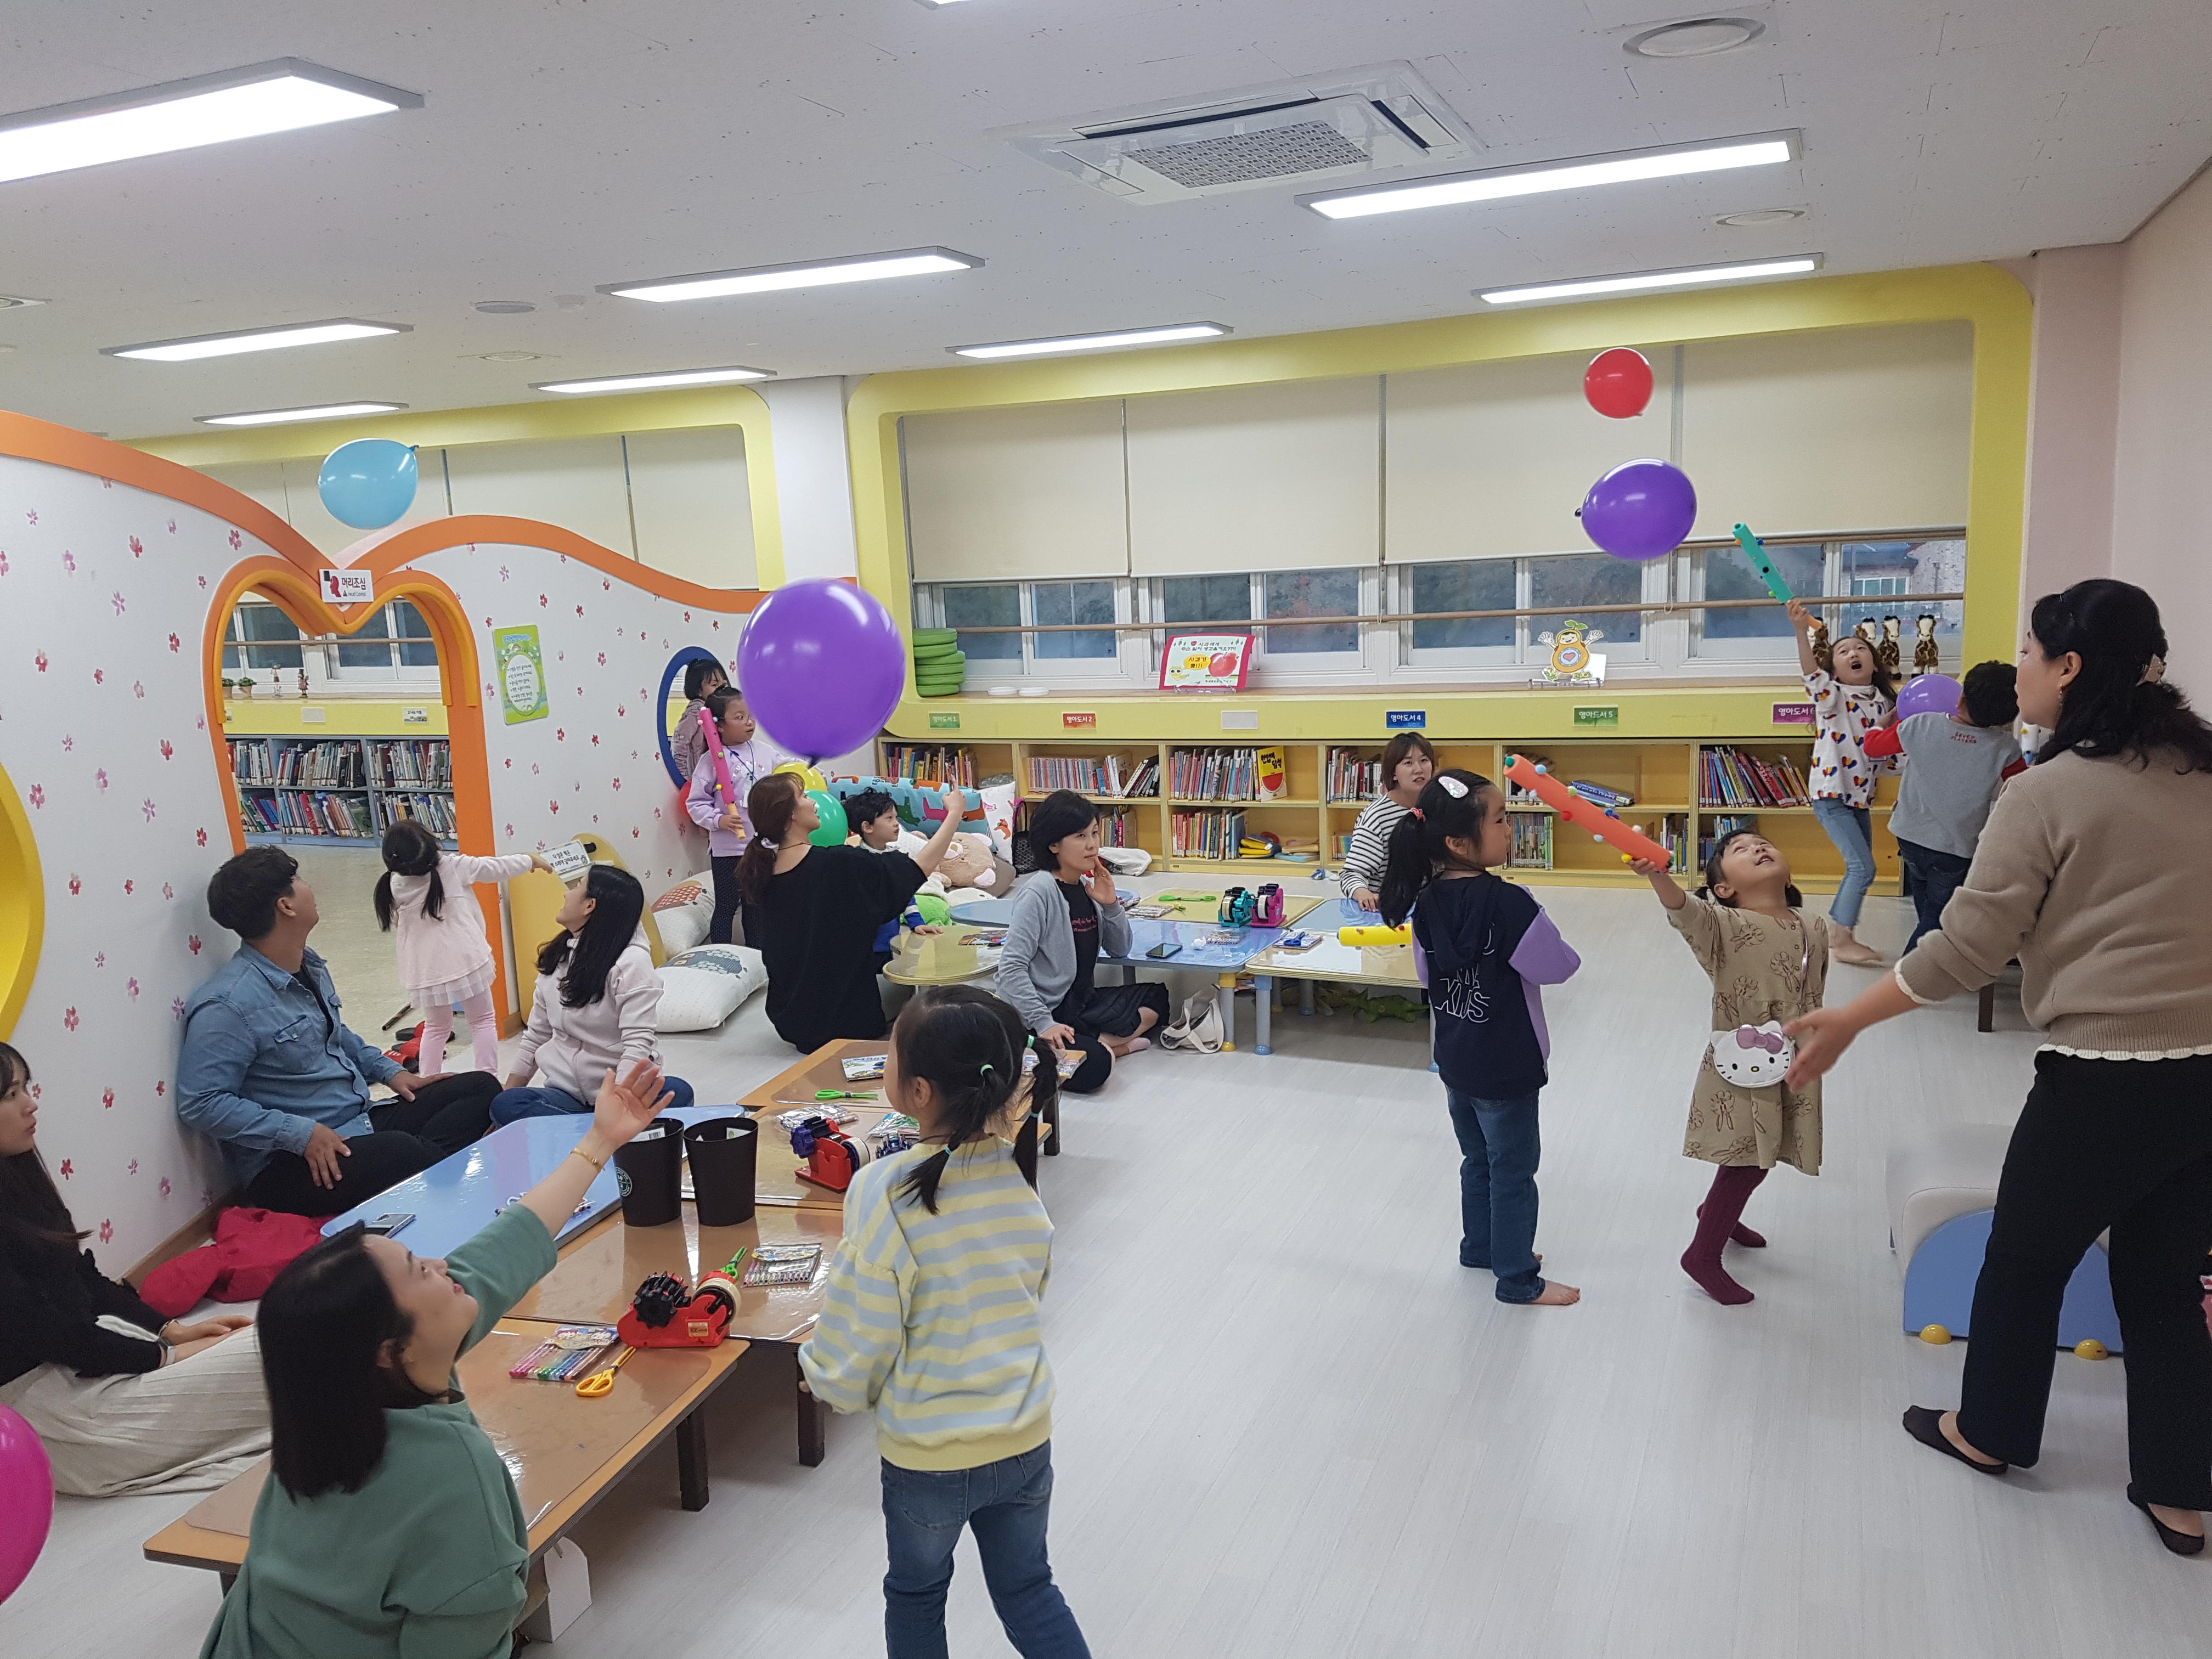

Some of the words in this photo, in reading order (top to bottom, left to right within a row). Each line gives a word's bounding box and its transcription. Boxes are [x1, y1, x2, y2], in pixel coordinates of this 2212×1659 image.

[342, 578, 366, 590] 머리조심
[1579, 711, 1607, 719] 영아도서
[1778, 707, 1809, 716] 영아도서
